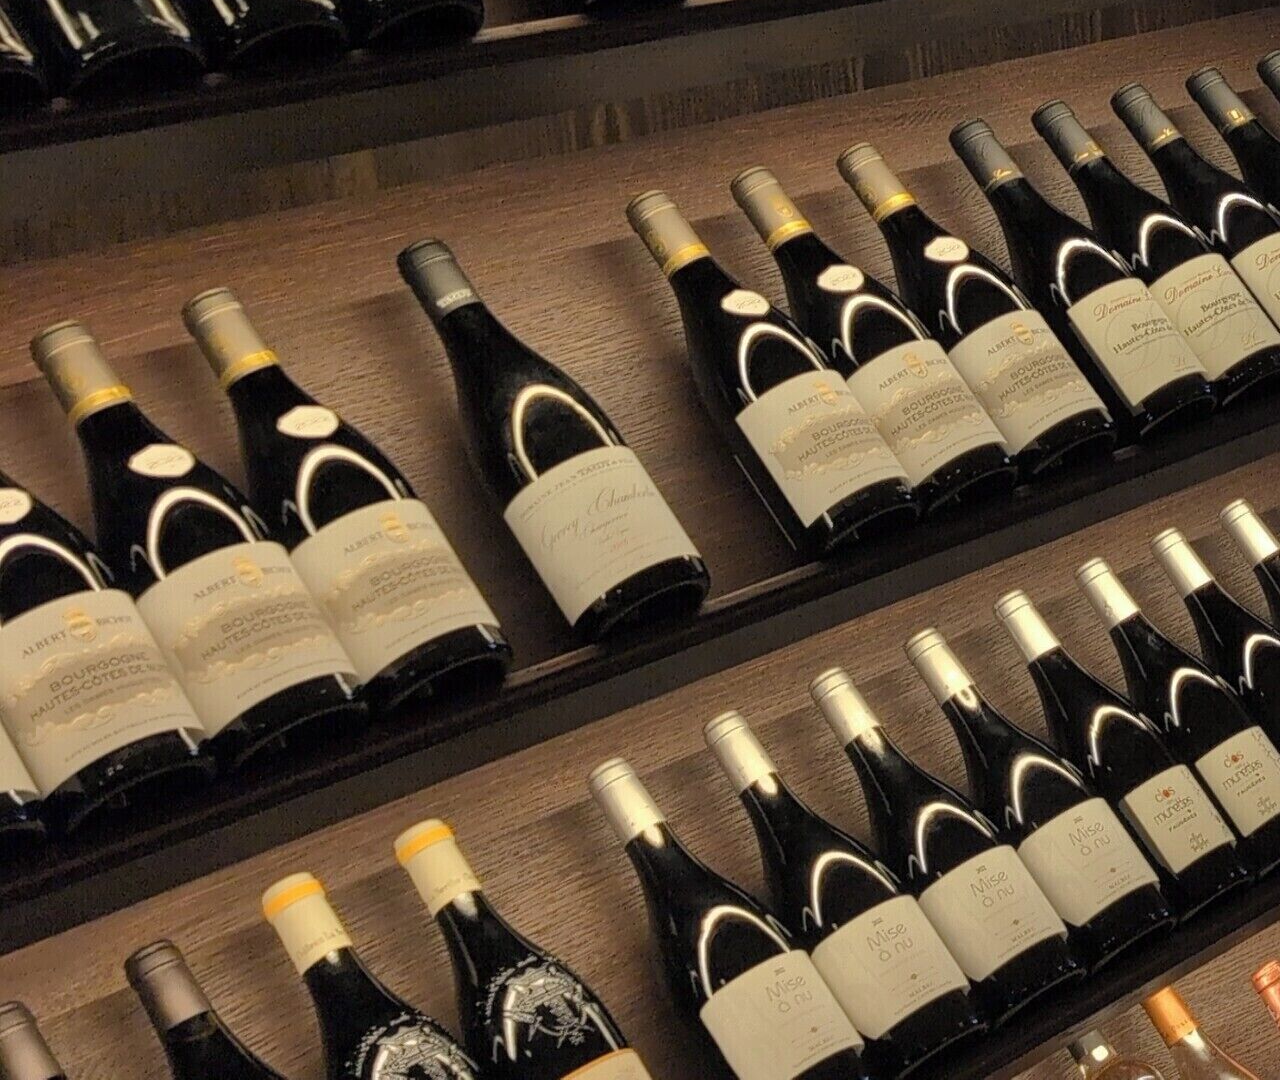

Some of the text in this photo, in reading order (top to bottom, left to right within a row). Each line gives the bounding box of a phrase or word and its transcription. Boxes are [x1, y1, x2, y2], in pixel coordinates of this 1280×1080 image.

[987, 335, 1018, 356] ALBERT
[879, 368, 909, 390] ALBERT
[788, 395, 819, 414] ALBERT
[344, 531, 383, 555] ALBERT
[194, 575, 237, 601] ALBERT
[22, 630, 67, 659] ALBERT
[50, 652, 150, 693] BOURGOGNE
[31, 665, 128, 721] HAUTES-CÔTES
[1068, 821, 1105, 846] Mise
[1094, 834, 1111, 849] nu
[970, 871, 1008, 898] Mise
[997, 884, 1015, 901] nu
[867, 923, 907, 952] Mise
[894, 937, 914, 954] nu
[765, 976, 807, 1002] Mise
[794, 990, 813, 1005] nu
